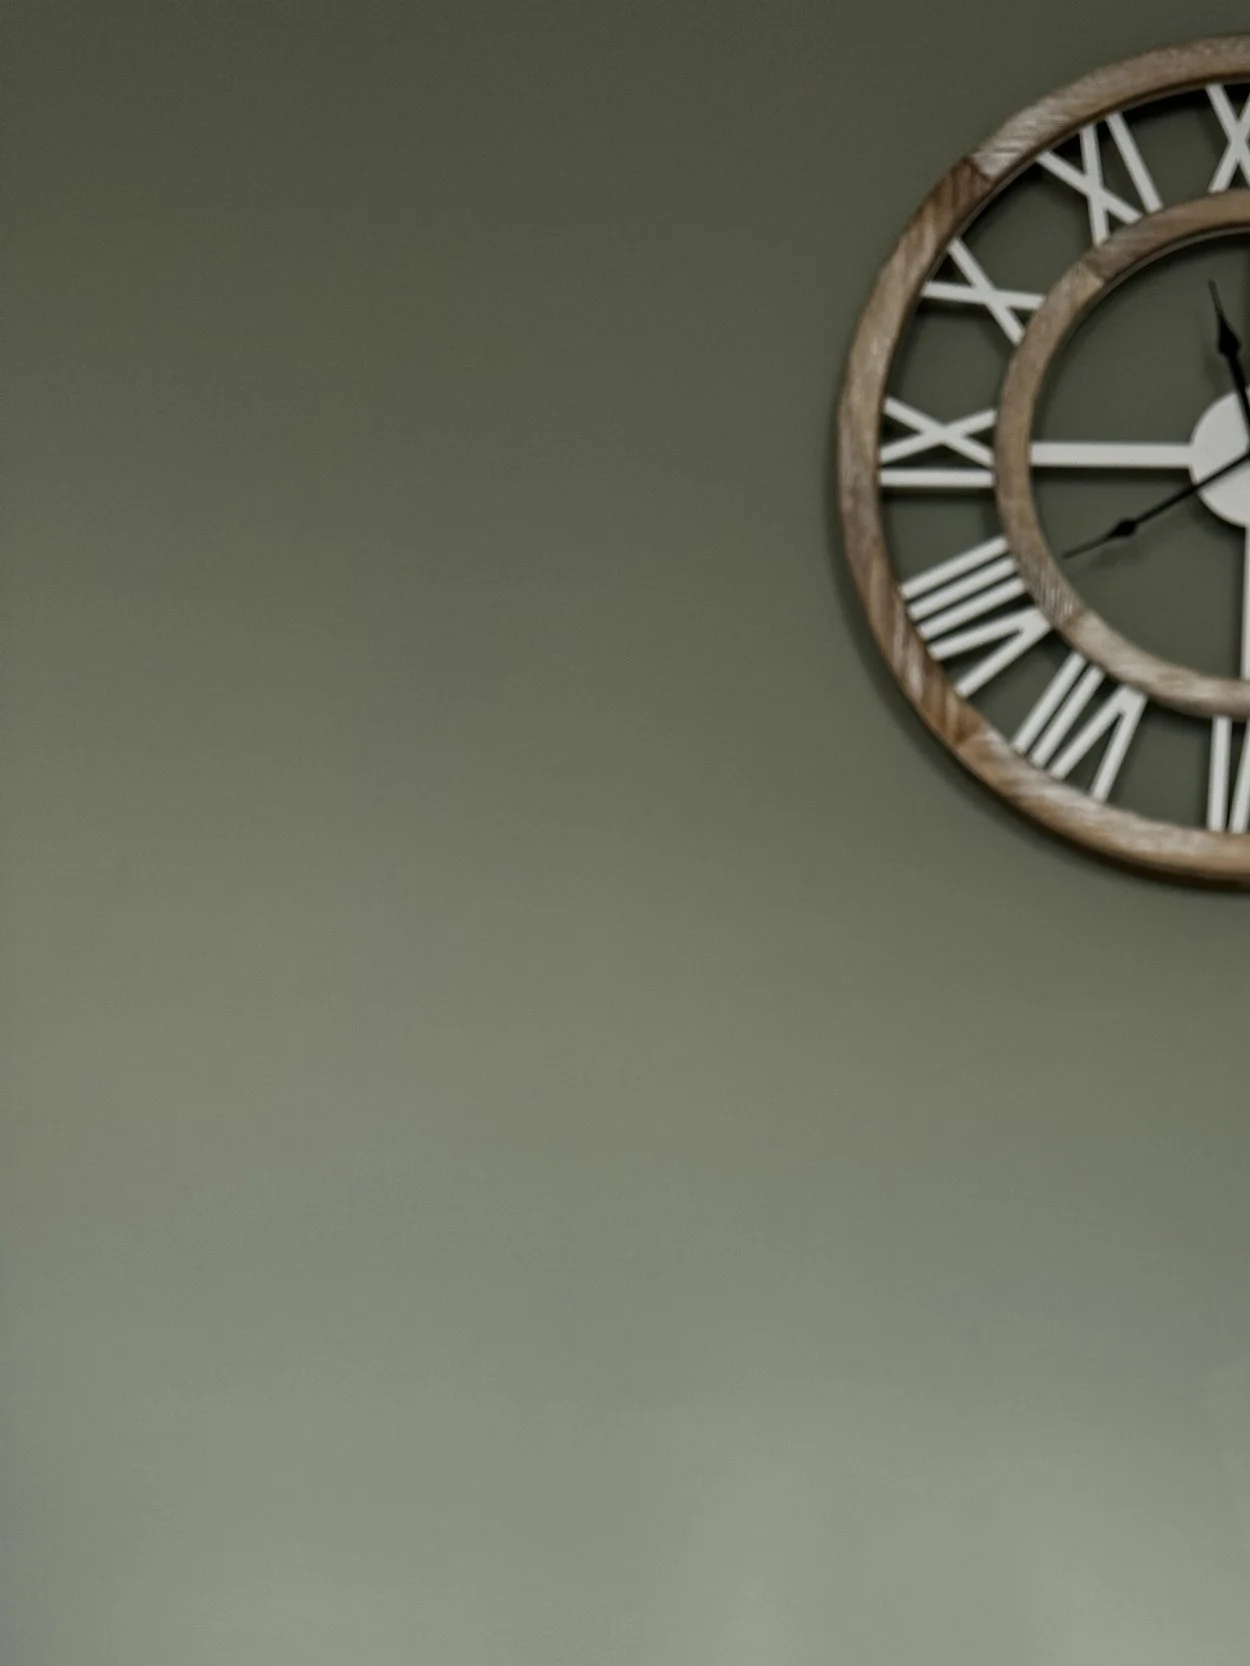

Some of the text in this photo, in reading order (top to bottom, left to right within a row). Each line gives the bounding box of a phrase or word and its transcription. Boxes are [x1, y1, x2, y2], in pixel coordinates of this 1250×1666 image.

[1036, 111, 1163, 247] XI
[921, 236, 1044, 347] X
[877, 396, 999, 489] IX
[899, 537, 1054, 697] VIII
[1010, 652, 1149, 803] VII
